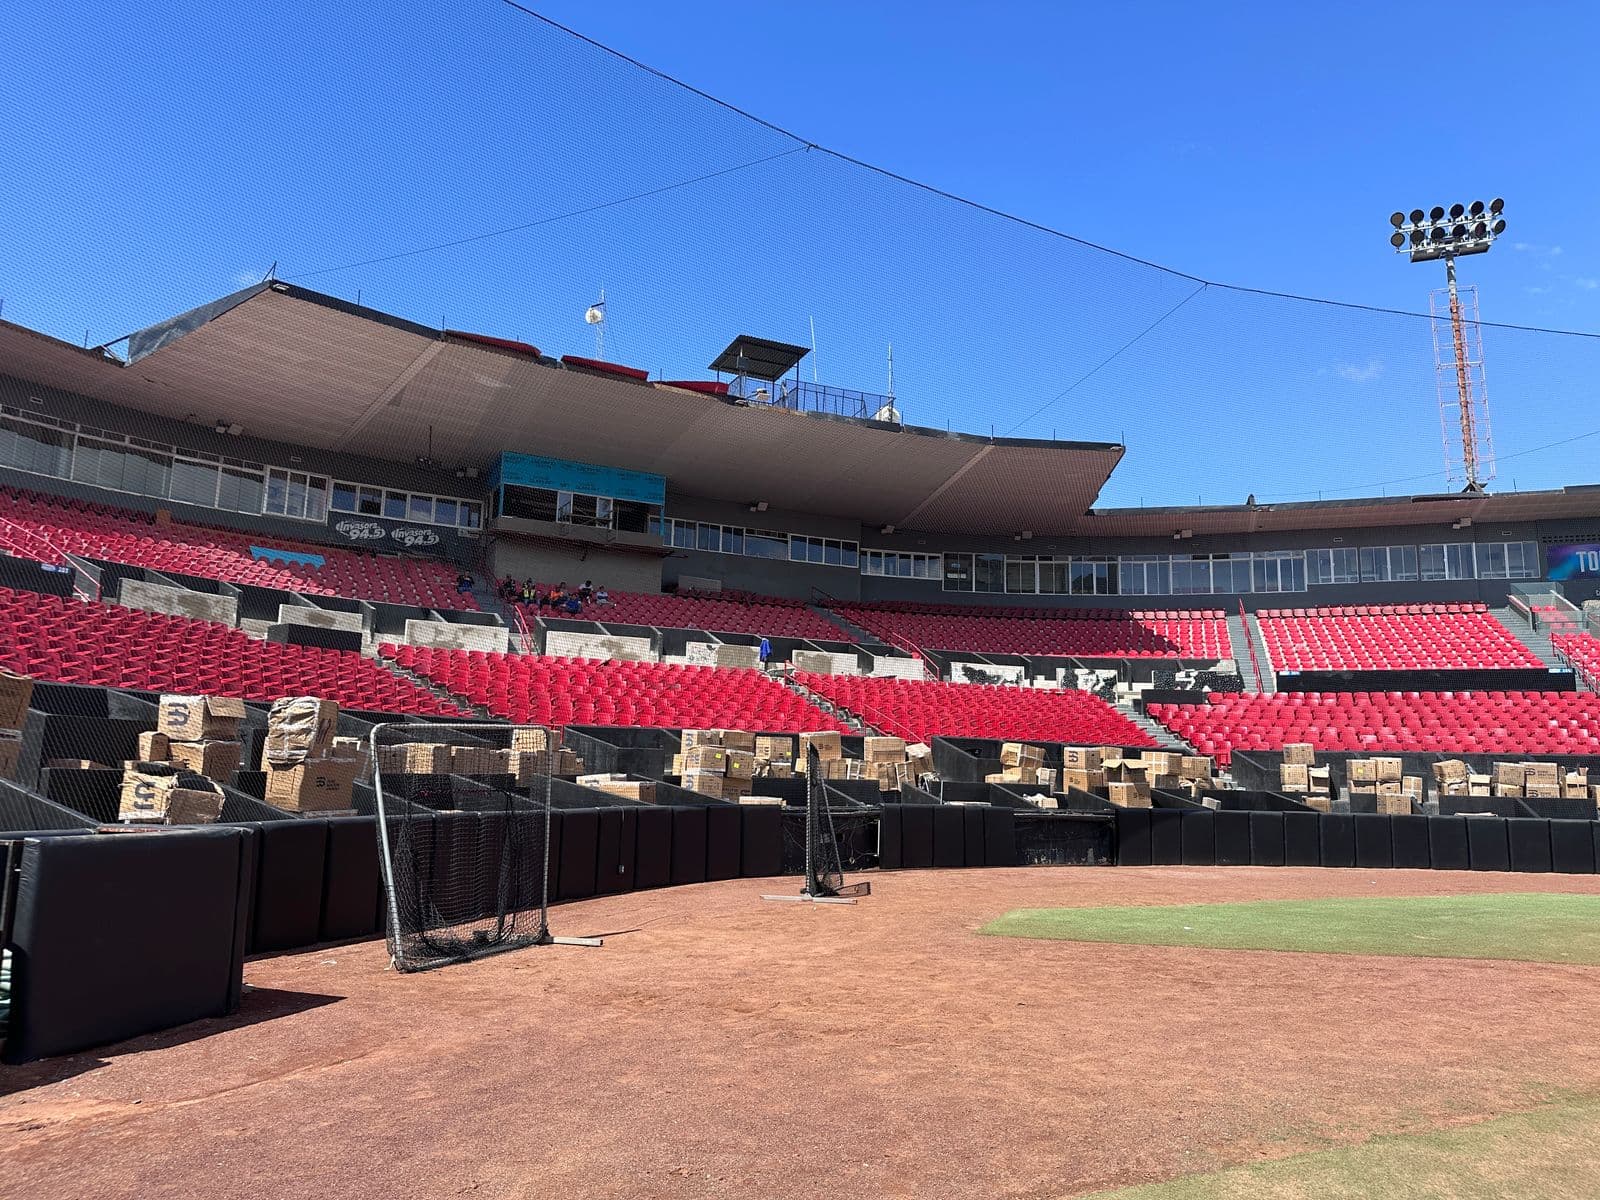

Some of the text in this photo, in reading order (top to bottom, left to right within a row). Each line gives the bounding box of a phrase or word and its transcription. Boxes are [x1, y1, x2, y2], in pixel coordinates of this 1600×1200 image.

[349, 528, 381, 540] 94.5
[404, 536, 435, 547] 94.5
[1576, 550, 1600, 572] TO
